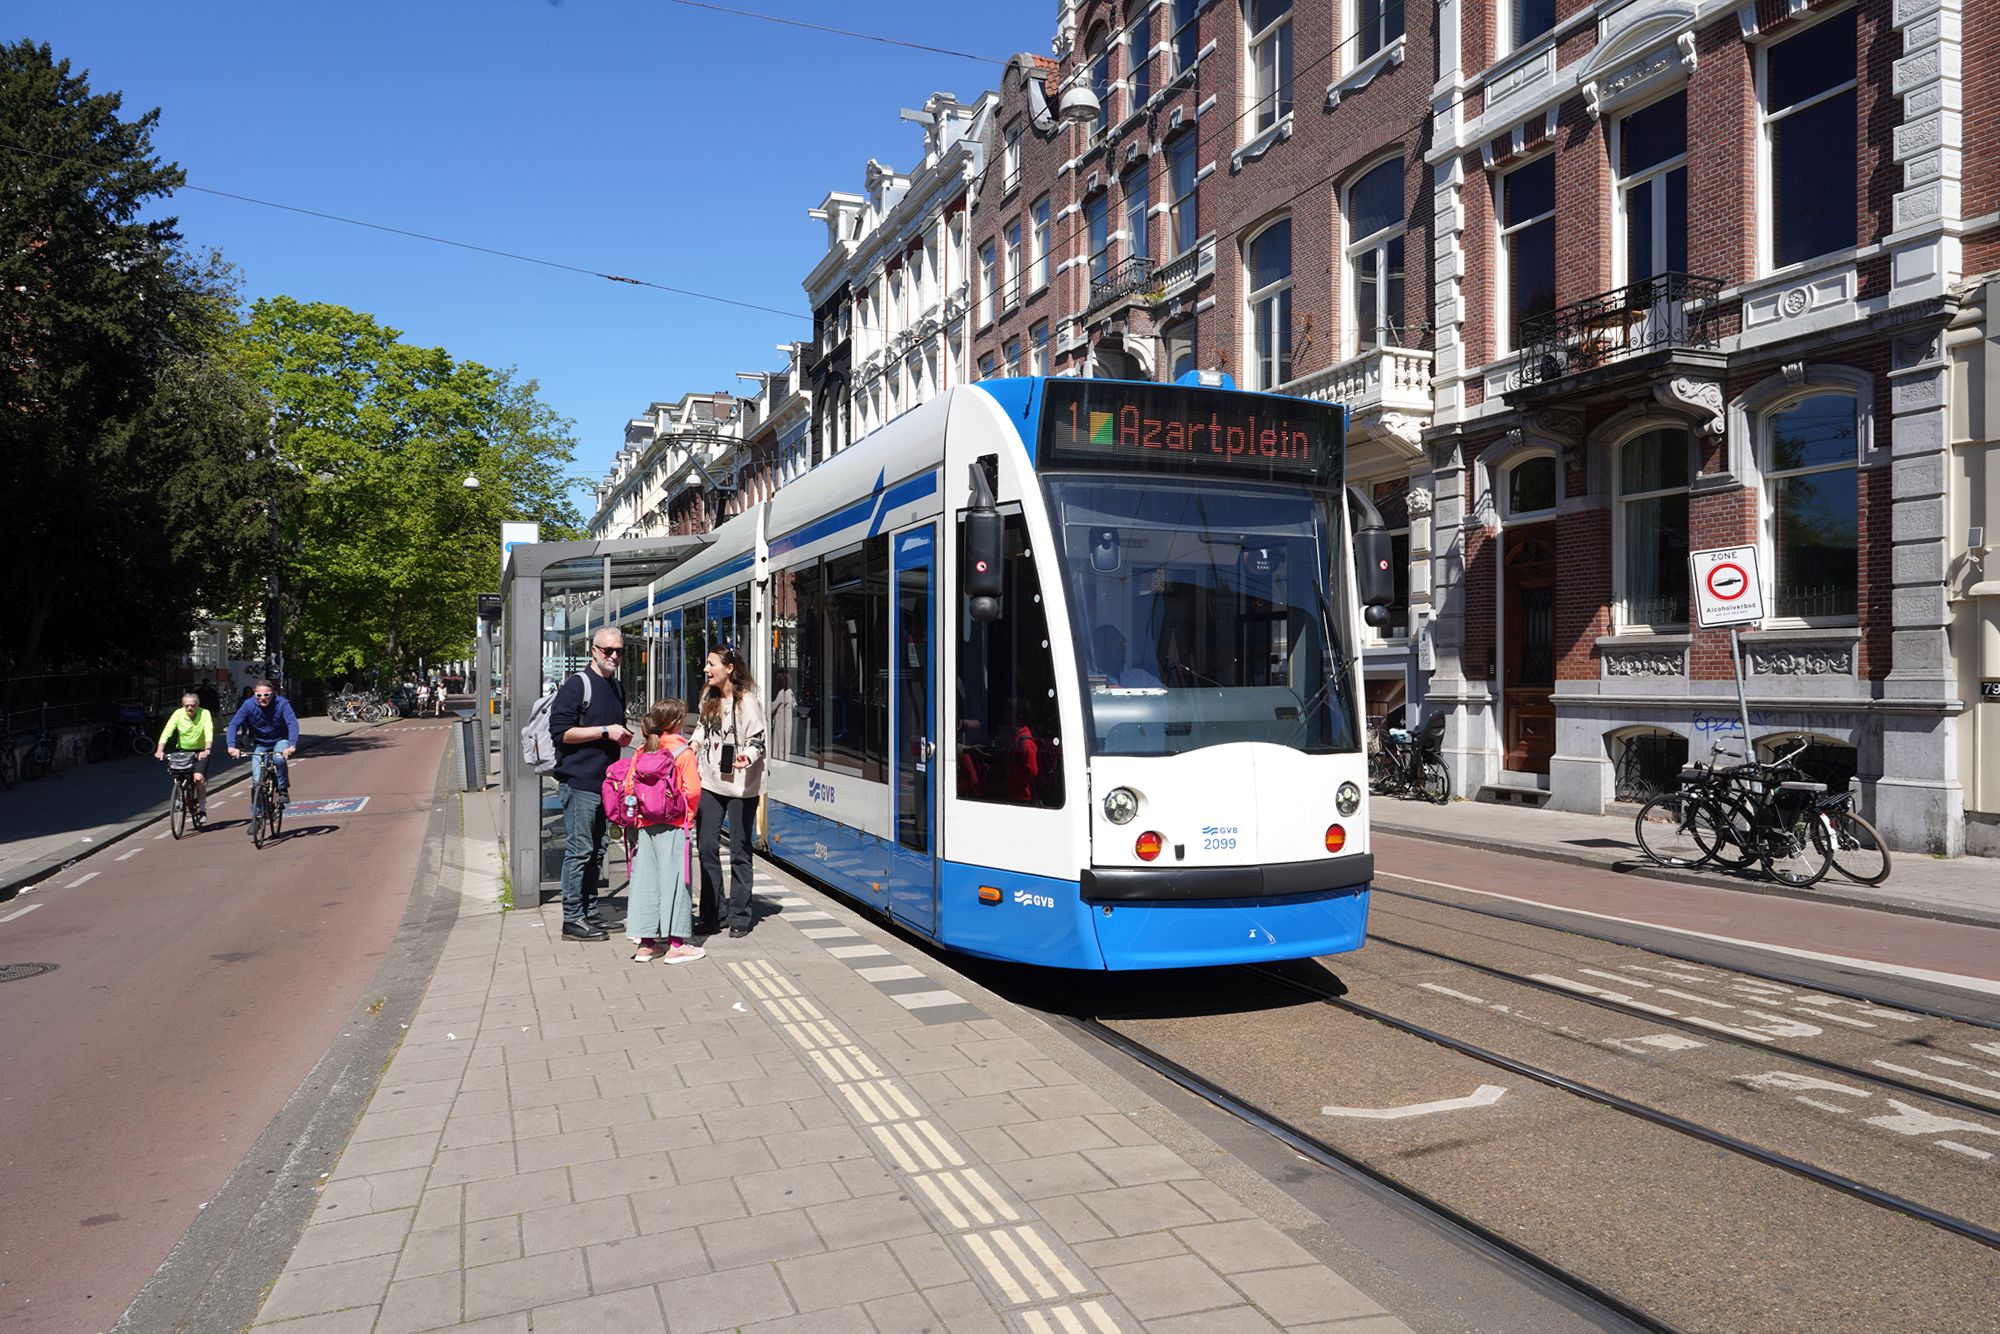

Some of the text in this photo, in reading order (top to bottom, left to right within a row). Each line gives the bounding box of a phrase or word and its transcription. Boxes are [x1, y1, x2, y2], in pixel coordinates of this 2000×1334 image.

[1068, 401, 1309, 462] 1 Azartplein
[1710, 551, 1738, 561] ZONE
[1706, 602, 1757, 613] Alcoholverbod
[820, 783, 836, 803] GVB
[1219, 826, 1238, 834] GVB
[1203, 838, 1237, 850] 2099
[1033, 895, 1055, 908] GVB
